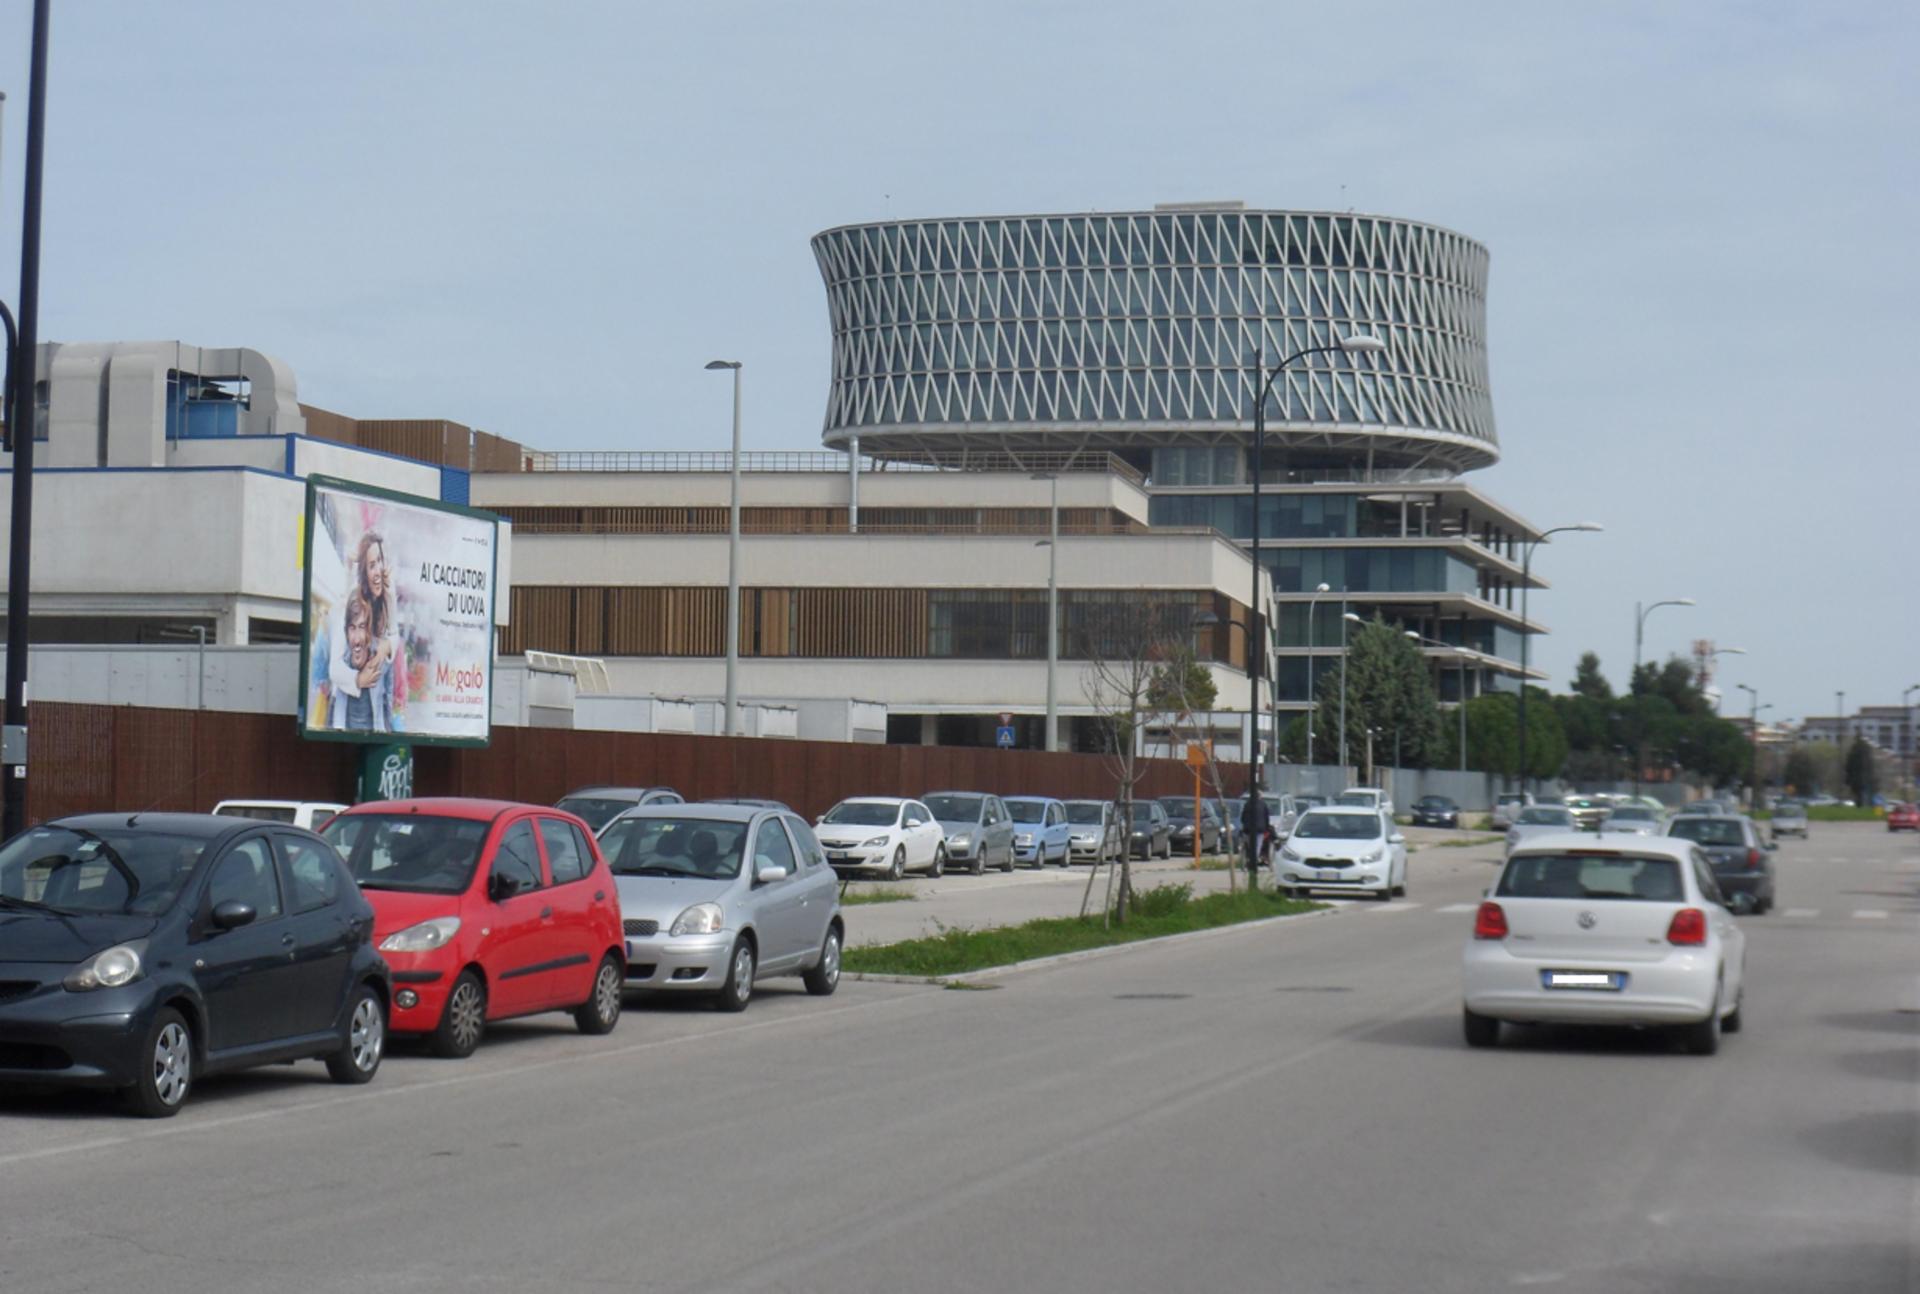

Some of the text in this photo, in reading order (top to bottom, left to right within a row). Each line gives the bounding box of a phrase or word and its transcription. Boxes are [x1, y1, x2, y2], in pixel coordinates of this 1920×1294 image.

[420, 561, 487, 591] AI CACCIATORI
[447, 592, 485, 616] DI UOVA
